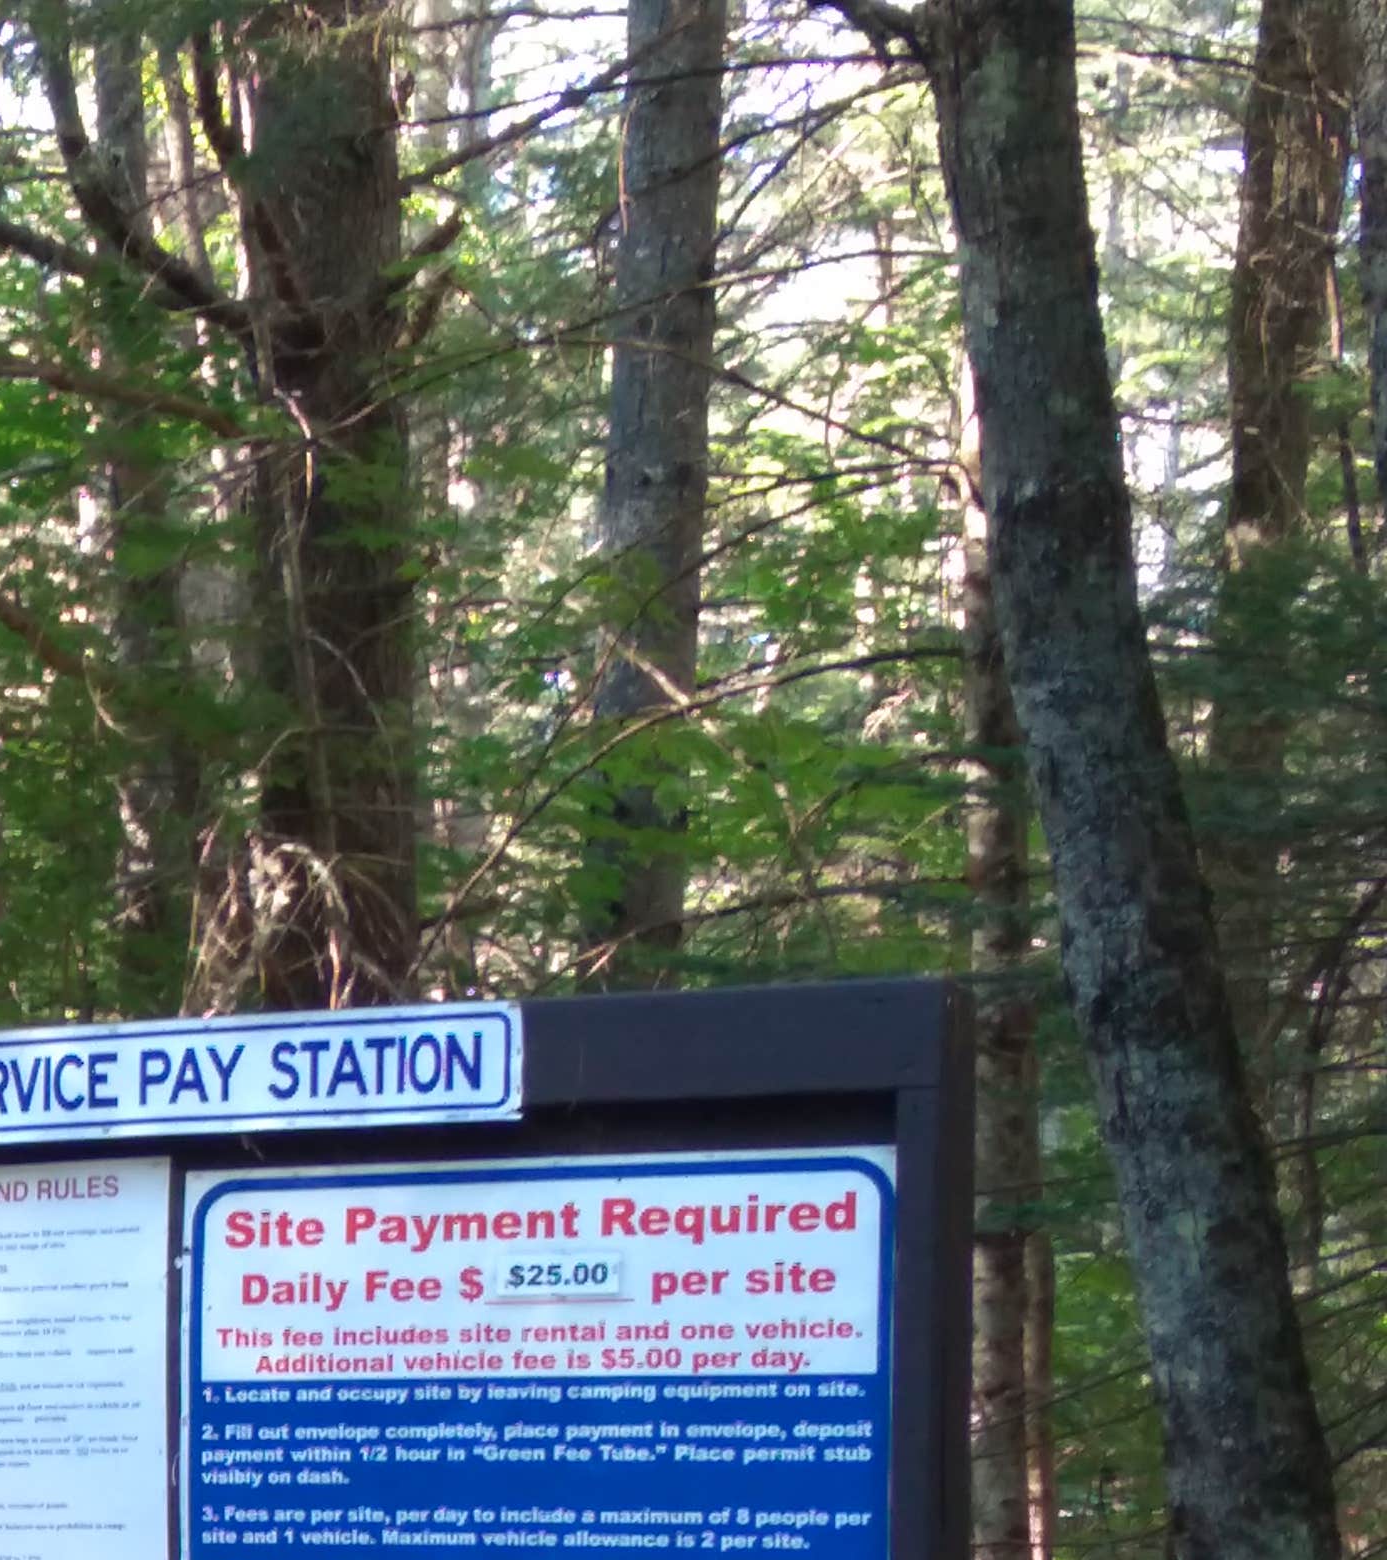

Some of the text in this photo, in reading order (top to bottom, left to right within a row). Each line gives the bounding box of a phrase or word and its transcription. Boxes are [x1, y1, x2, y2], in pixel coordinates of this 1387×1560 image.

[139, 1047, 243, 1110] PAY
[269, 1032, 481, 1103] STATION
[36, 1175, 118, 1202] RULES
[225, 1192, 855, 1253] Site Payment Required
[242, 1271, 347, 1312] Daily
[365, 1269, 441, 1303] Fee
[507, 1262, 609, 1288] $25.00
[651, 1271, 729, 1304] per
[745, 1261, 835, 1294] site
[216, 1319, 862, 1347] This fee includes site rental and one vehicle.
[255, 1347, 810, 1374] Additional vehicle fee is $5.00 per day.
[225, 1386, 290, 1403] Locate
[295, 1386, 332, 1402] and
[336, 1389, 409, 1406] occupy
[413, 1385, 451, 1401] site
[457, 1385, 482, 1405] by
[567, 1383, 656, 1404] camping
[663, 1382, 777, 1403] equipment
[784, 1385, 810, 1398] on
[225, 1424, 252, 1440] Fill
[258, 1424, 289, 1440] out
[294, 1424, 380, 1444] envelope
[503, 1423, 559, 1443] place
[565, 1422, 653, 1442] payment
[660, 1422, 679, 1438] in
[792, 1422, 871, 1441] deposit
[201, 1447, 283, 1466] payment
[290, 1446, 351, 1462] within
[359, 1446, 387, 1462] 1/2
[395, 1446, 440, 1462] hour
[447, 1446, 465, 1462] in
[553, 1446, 591, 1461] Fee
[674, 1445, 735, 1461] Place
[743, 1445, 815, 1465] permit
[824, 1445, 871, 1461] stub
[201, 1469, 349, 1488] visibly on dash.
[224, 1507, 871, 1529] Fees are per site, per day to include maximum people per
[202, 1530, 237, 1544] site
[242, 1530, 277, 1544] and
[300, 1530, 375, 1545] vehicle.
[381, 1531, 476, 1546] Maximum
[481, 1532, 557, 1547] vehicle
[563, 1532, 669, 1547] allowance
[721, 1537, 756, 1552] per
